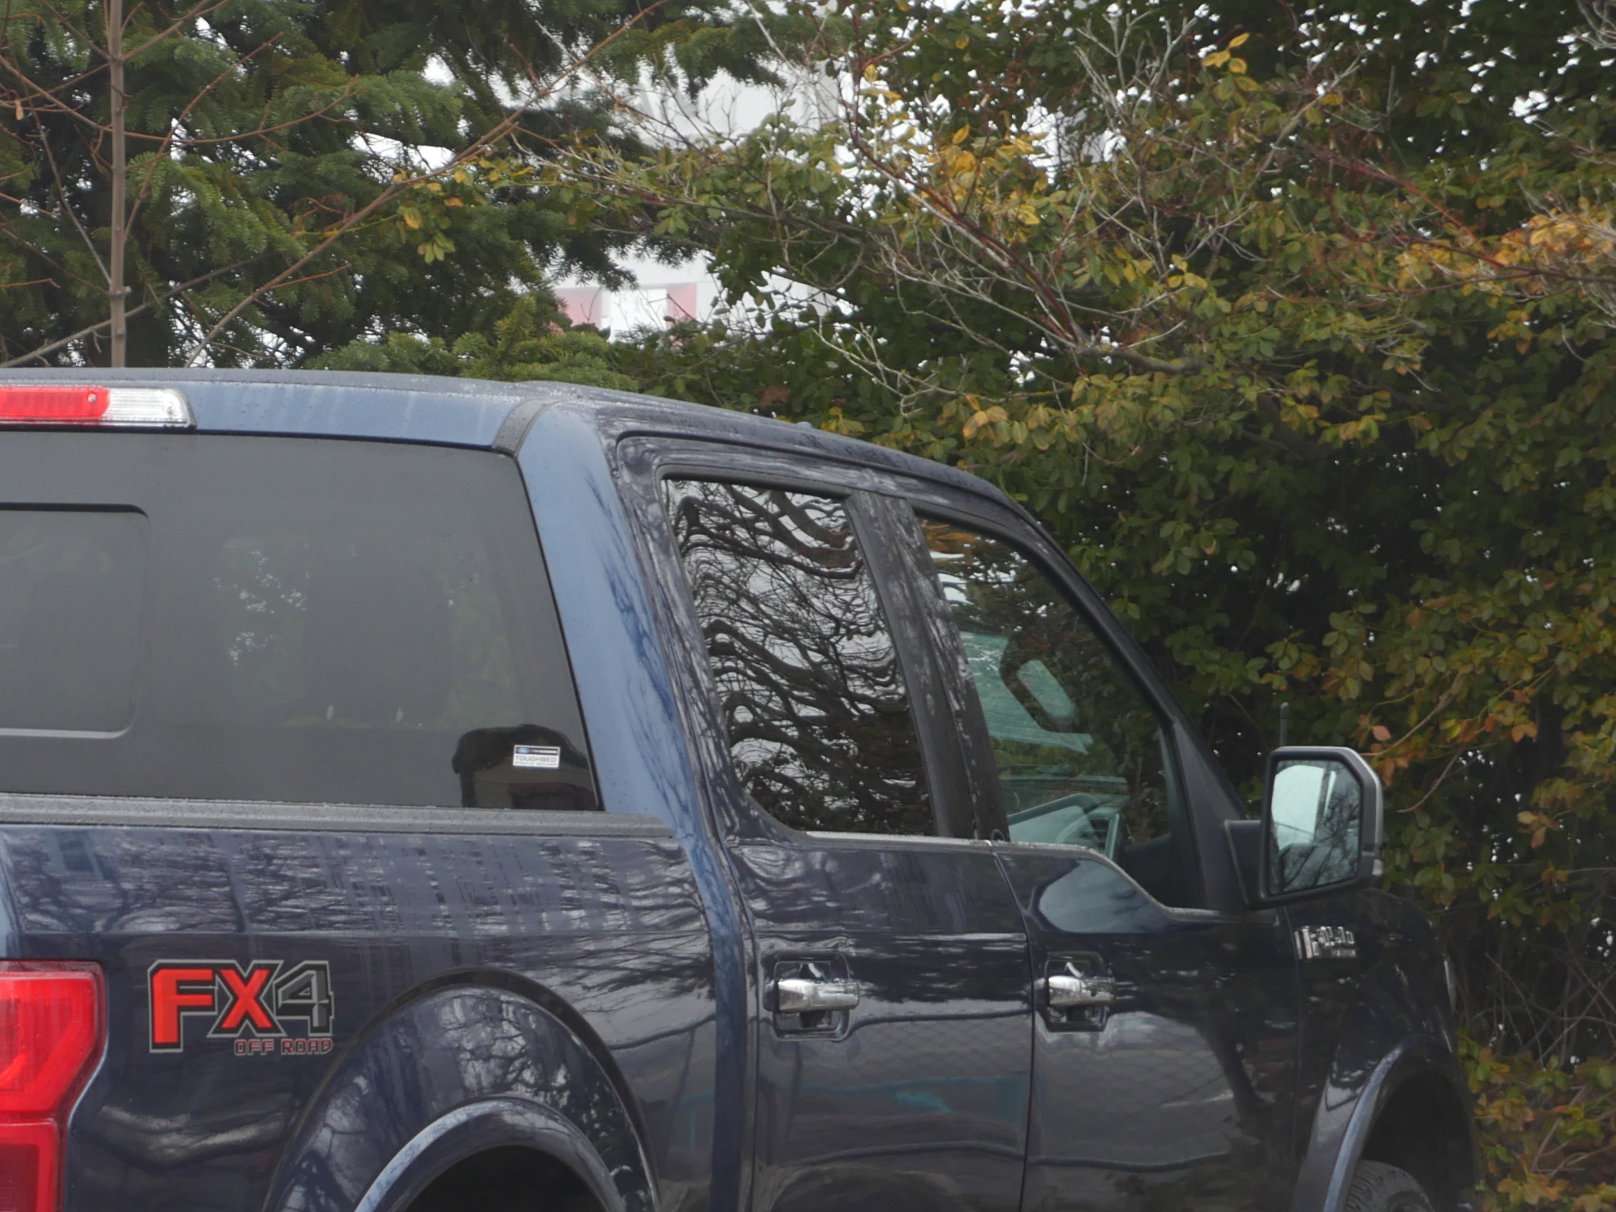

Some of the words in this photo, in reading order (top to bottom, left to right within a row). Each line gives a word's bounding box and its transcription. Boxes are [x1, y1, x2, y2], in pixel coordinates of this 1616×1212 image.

[147, 958, 334, 1053] FX4
[234, 1038, 275, 1055] OFF
[280, 1037, 333, 1055] ROAD
